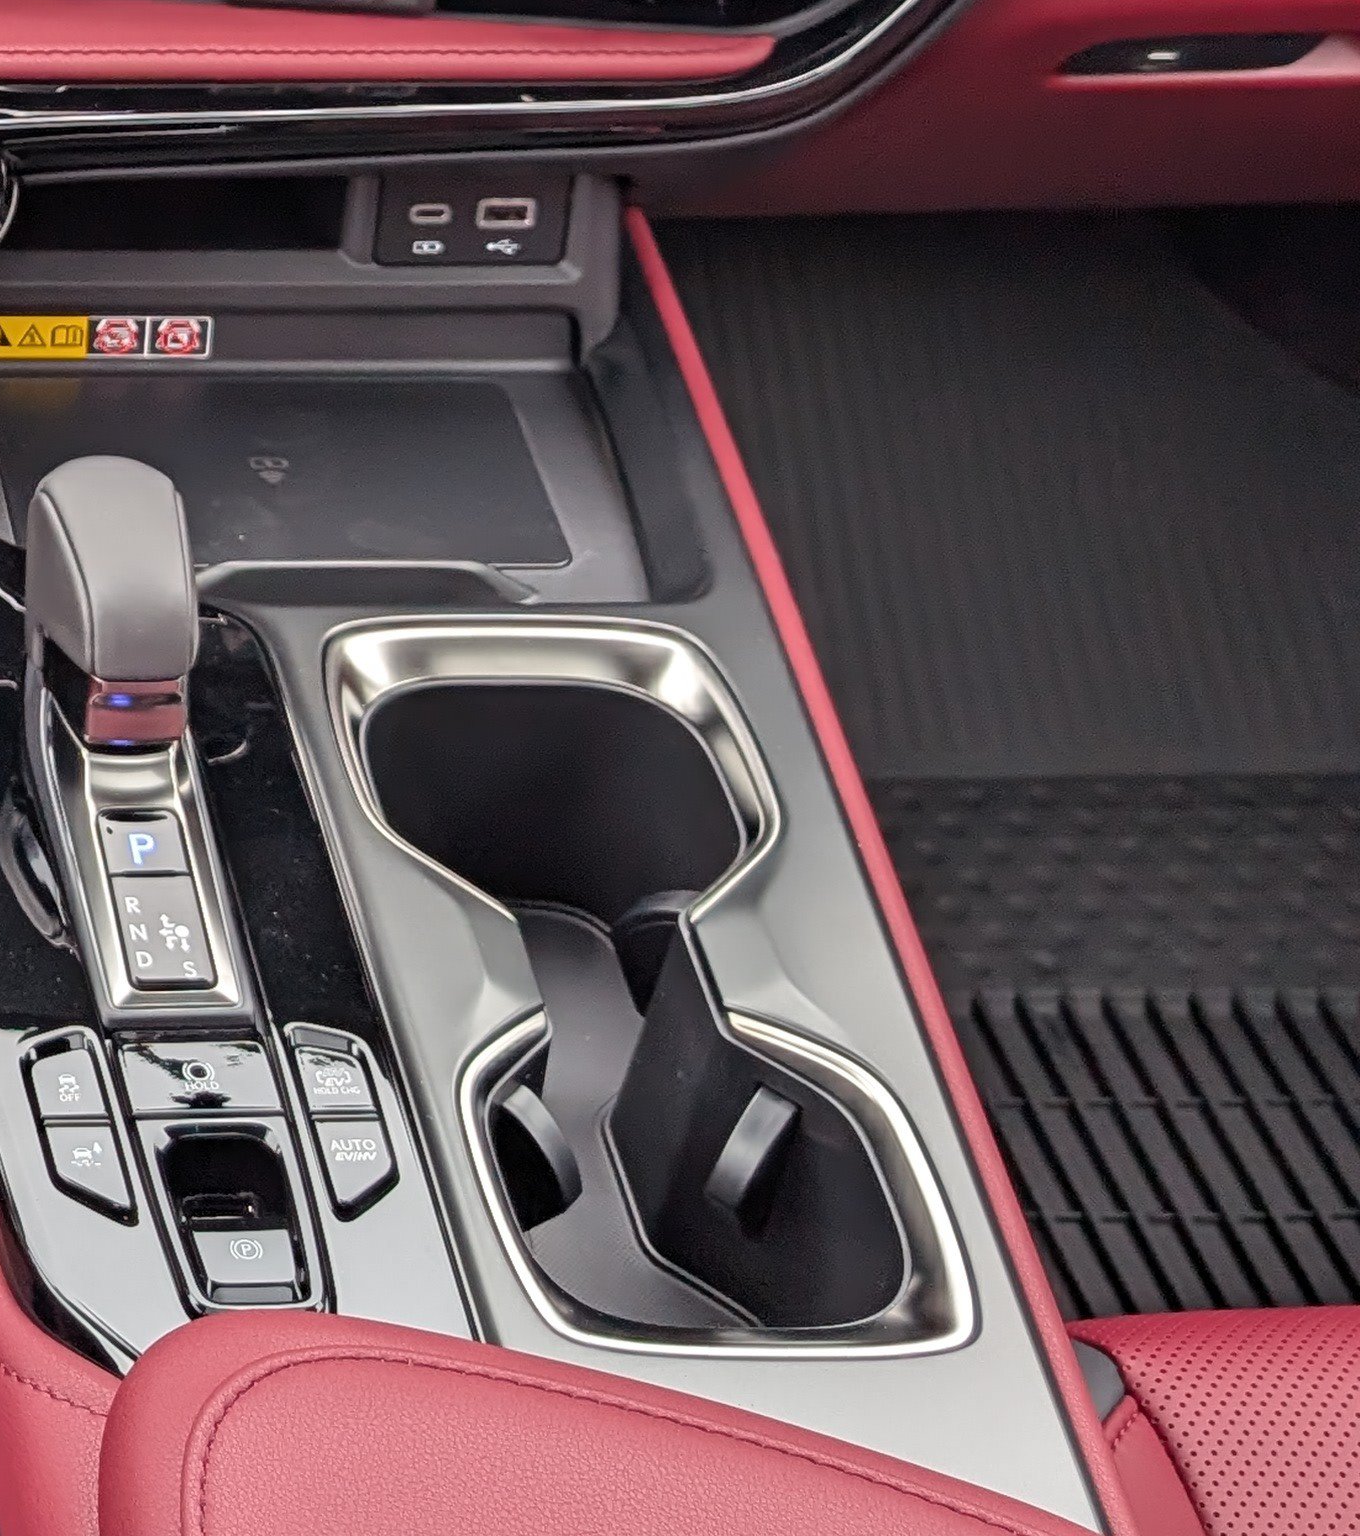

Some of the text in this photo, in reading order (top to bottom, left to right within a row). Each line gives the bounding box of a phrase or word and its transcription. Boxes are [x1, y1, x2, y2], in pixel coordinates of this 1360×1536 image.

[128, 832, 156, 866] P
[124, 895, 141, 915] R
[128, 922, 149, 942] N
[135, 950, 154, 969] D
[182, 960, 198, 979] S
[184, 1080, 220, 1092] HOLD
[312, 1086, 339, 1095] HOLD
[59, 1092, 82, 1103] OFF
[330, 1138, 377, 1152] AUTO
[334, 1150, 378, 1162] EV/HV
